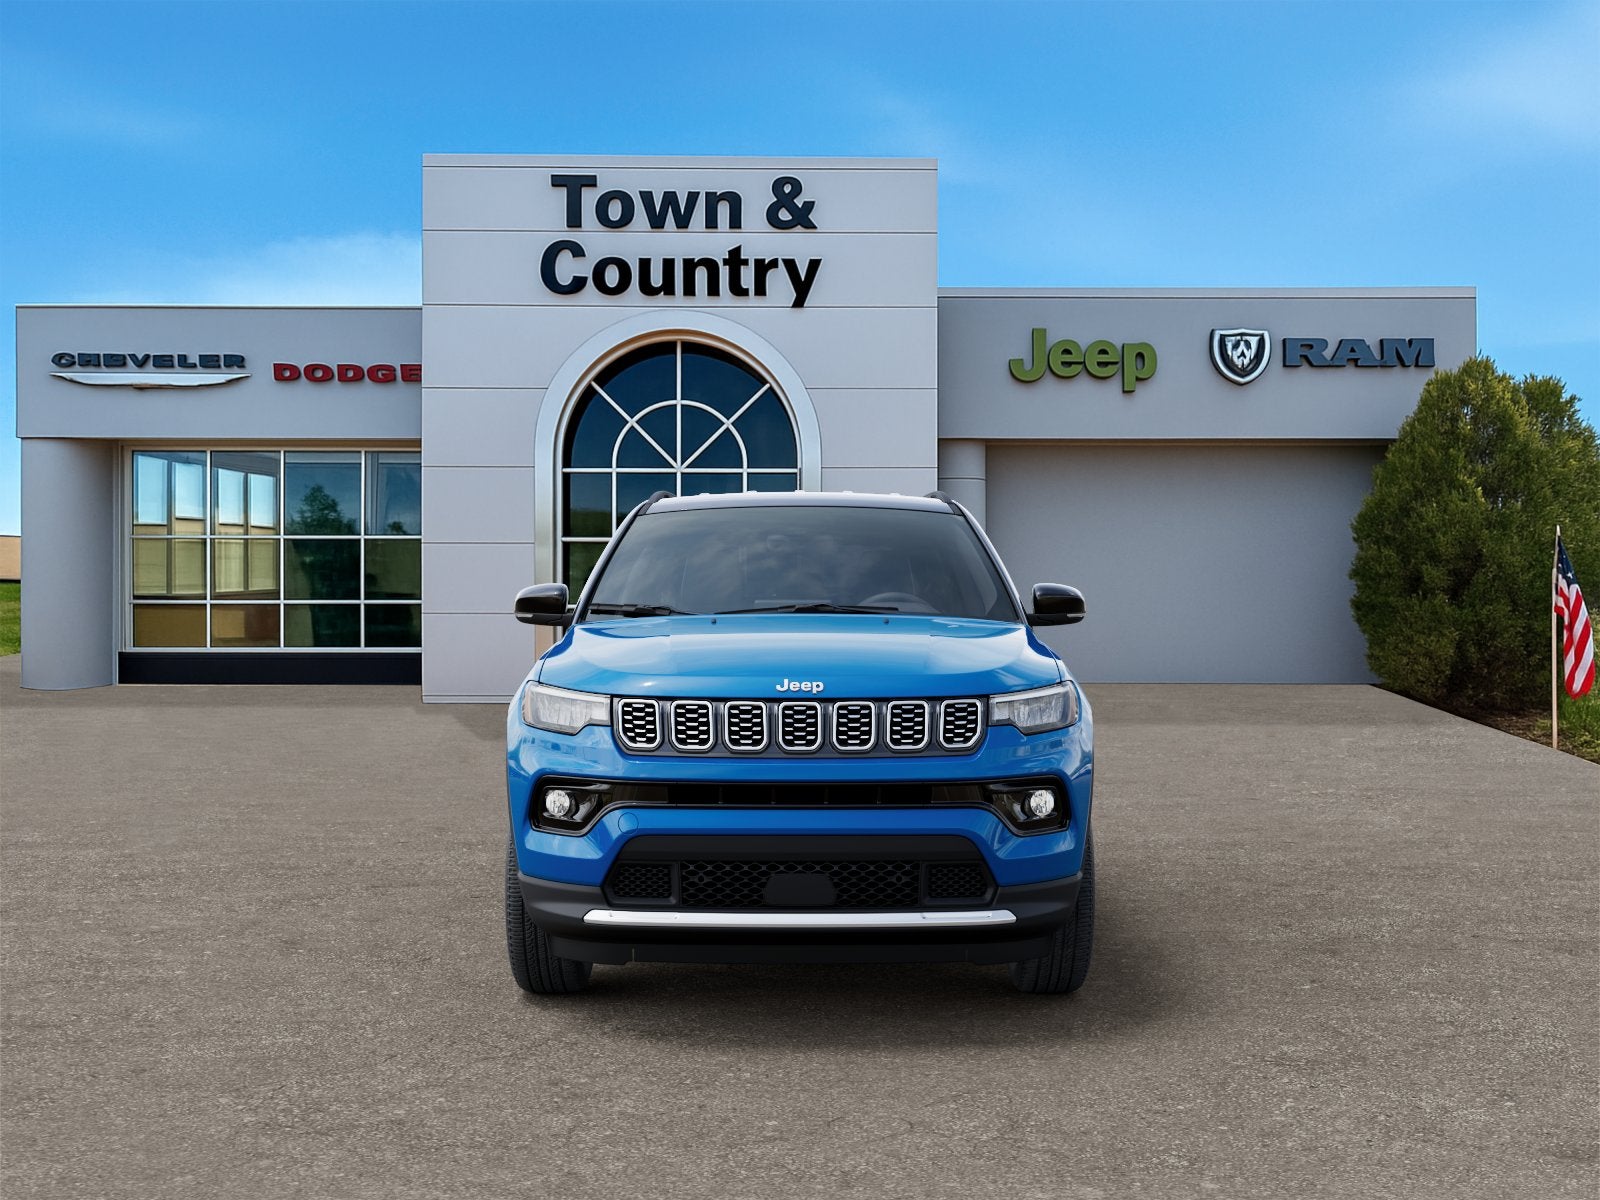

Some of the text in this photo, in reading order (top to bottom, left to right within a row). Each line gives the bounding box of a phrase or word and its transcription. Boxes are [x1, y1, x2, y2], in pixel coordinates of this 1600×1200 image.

[551, 174, 818, 230] Town &
[540, 240, 822, 308] Country
[273, 362, 422, 383] DODGE
[1009, 328, 1158, 393] Jeep
[1283, 337, 1436, 368] RAM
[775, 678, 824, 694] Jeep
